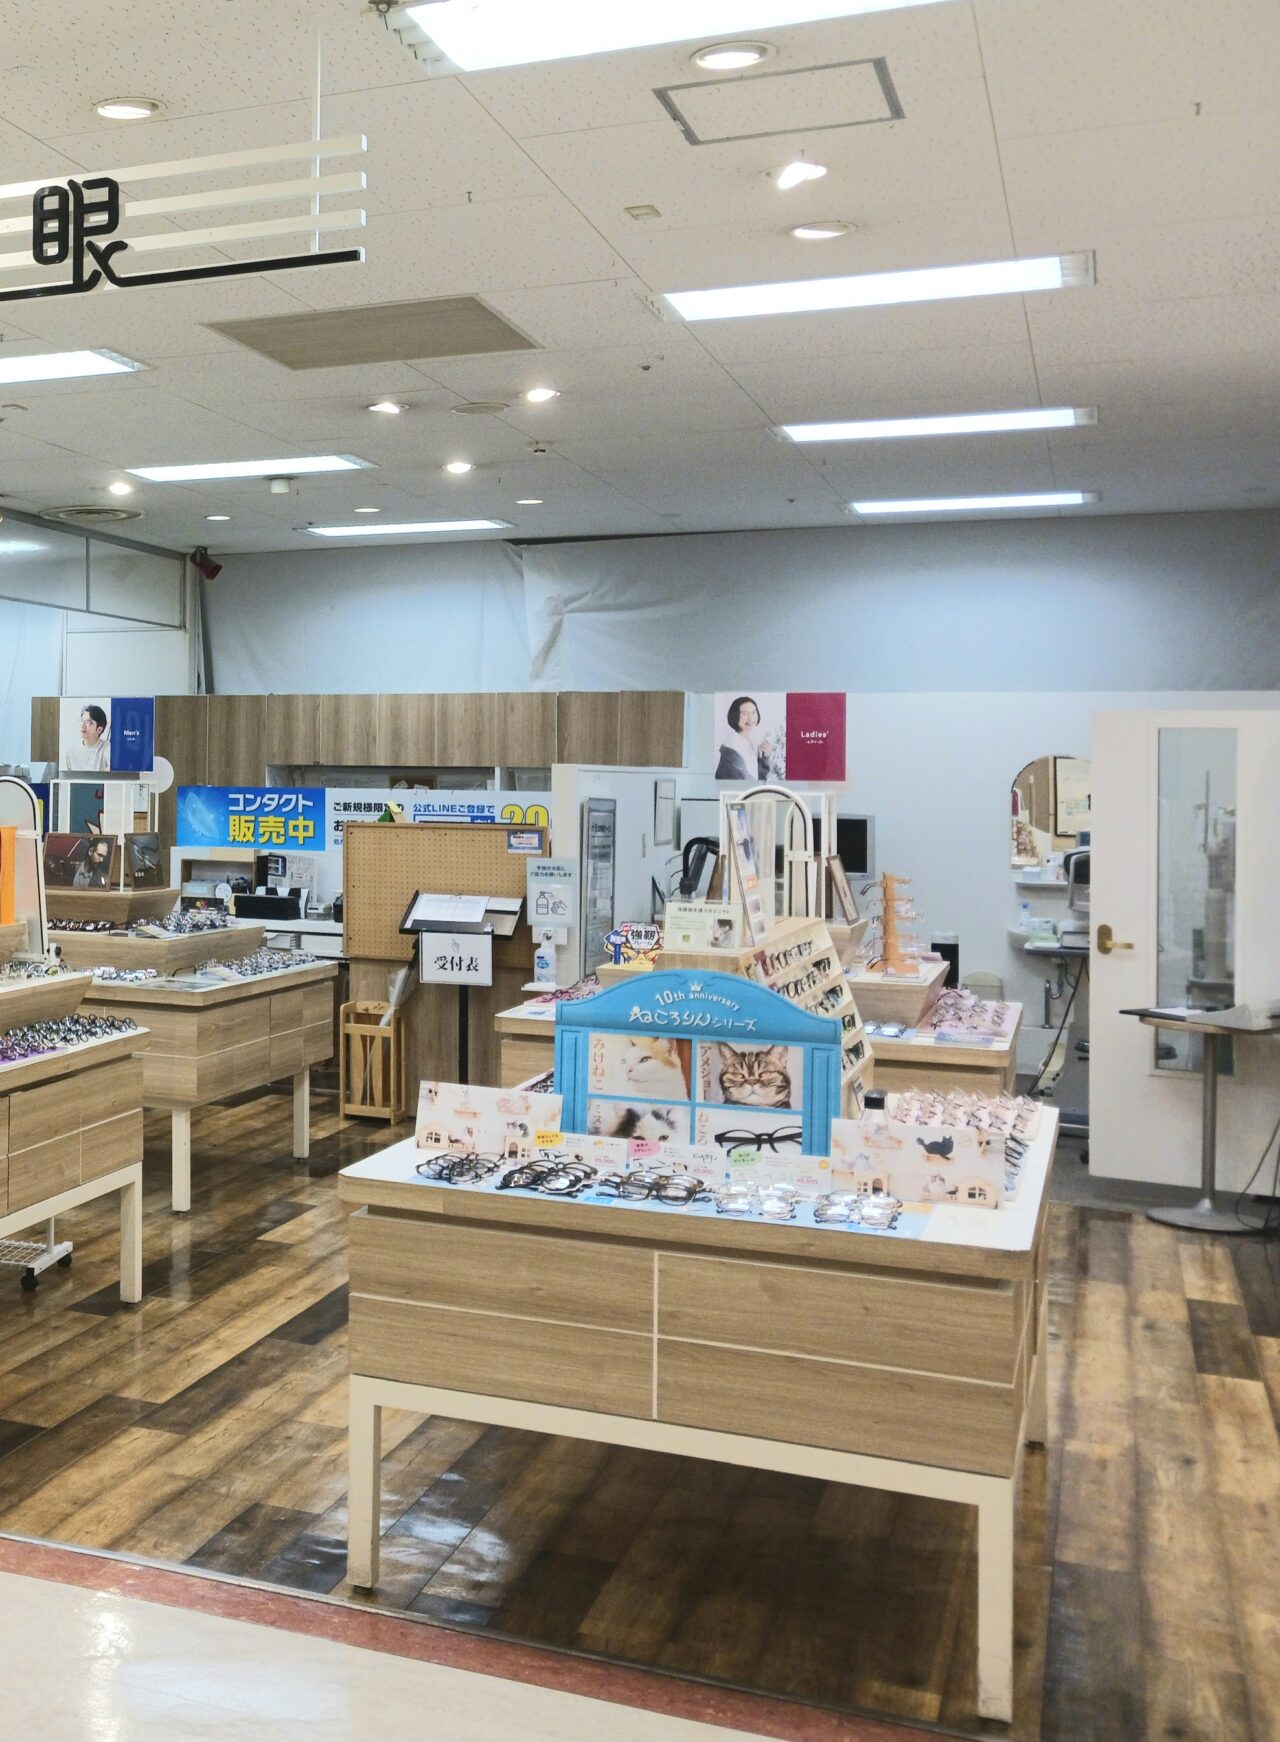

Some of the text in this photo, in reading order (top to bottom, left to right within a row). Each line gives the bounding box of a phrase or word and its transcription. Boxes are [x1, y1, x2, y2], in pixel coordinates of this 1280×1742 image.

[228, 793, 314, 813] コンタクト
[413, 803, 495, 814] 公式LINEご登録で
[228, 815, 315, 845] 販売中
[434, 955, 479, 972] 受付表
[655, 990, 741, 1012] 10th anniversary
[592, 1038, 606, 1091] みけねこ
